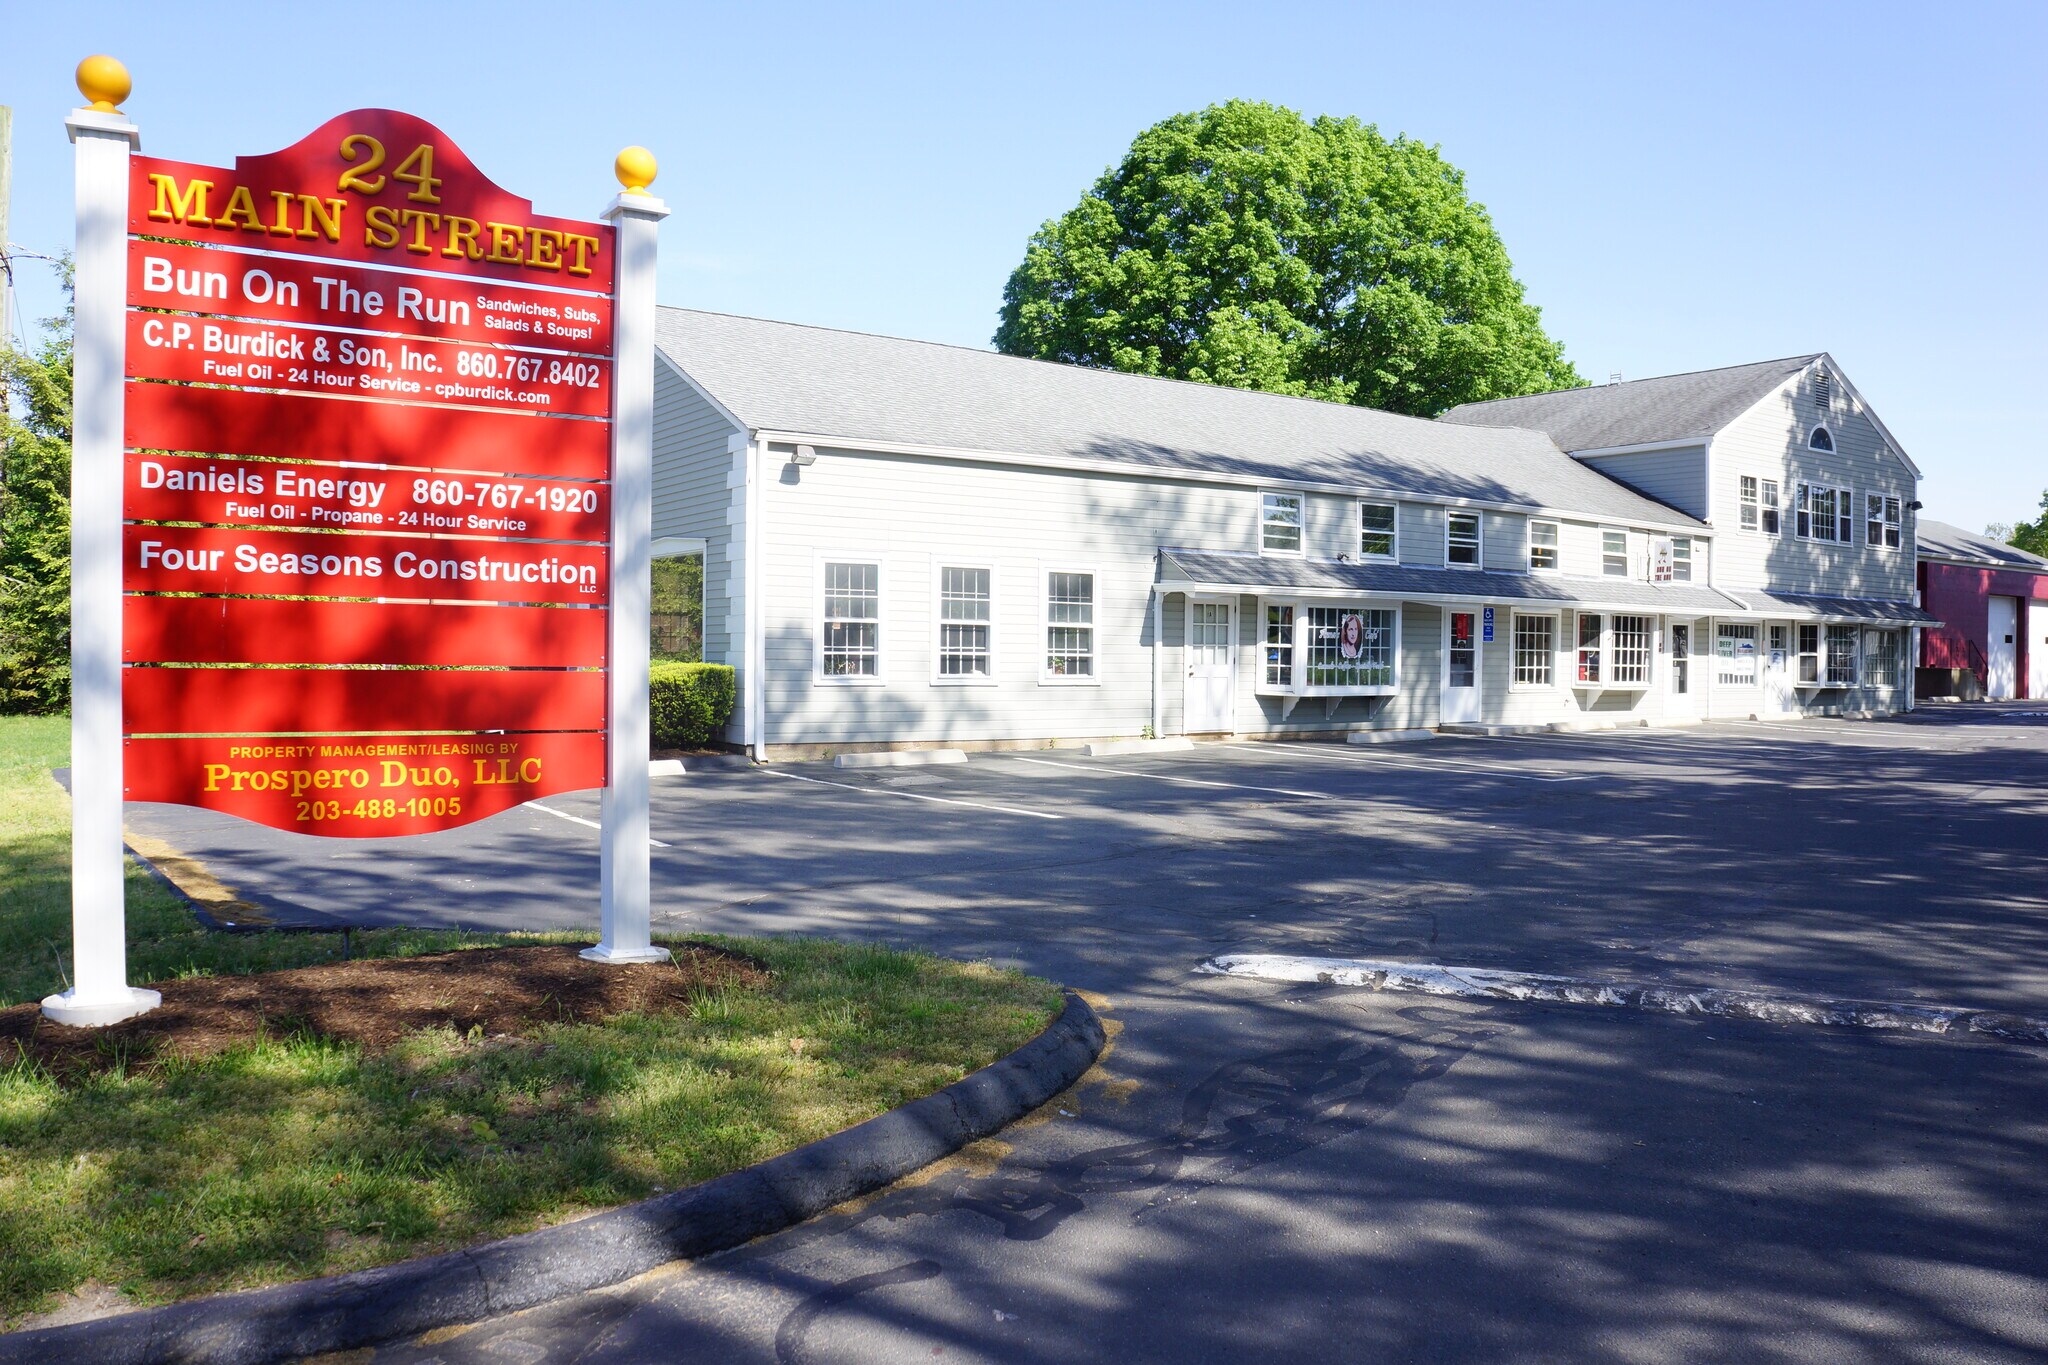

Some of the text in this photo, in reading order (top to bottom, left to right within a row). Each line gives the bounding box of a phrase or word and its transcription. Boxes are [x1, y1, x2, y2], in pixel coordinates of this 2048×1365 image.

[338, 134, 442, 204] 24
[148, 173, 600, 275] MAIN STREET
[143, 256, 472, 326] Bun On The Run
[477, 296, 601, 324] Sandwiches, Subs,
[484, 315, 592, 340] Salads & Soups!
[142, 320, 600, 388] C.P. Burdick & Son, Inc. 860.767.8402
[204, 360, 244, 377] Fuel
[247, 364, 272, 379] Oil
[288, 368, 308, 382] 24
[314, 370, 355, 387] Hour
[359, 373, 421, 393] Service
[435, 384, 551, 404] cpburdick.com
[141, 461, 598, 513] Daniels Energy 860-767-1920
[226, 502, 264, 518] Fuel
[270, 504, 294, 519] Oil
[312, 506, 383, 525] Propane
[398, 511, 418, 525] 24
[423, 513, 463, 527] Hour
[467, 515, 526, 530] Service
[141, 541, 596, 584] Four Seasons Construction
[580, 585, 596, 593] LLC
[230, 743, 519, 758] PROPERTY MANAGEMENT/LEASING BY
[204, 757, 543, 797] Prospero Duo, LLC
[296, 796, 462, 821] 203-488-1005
